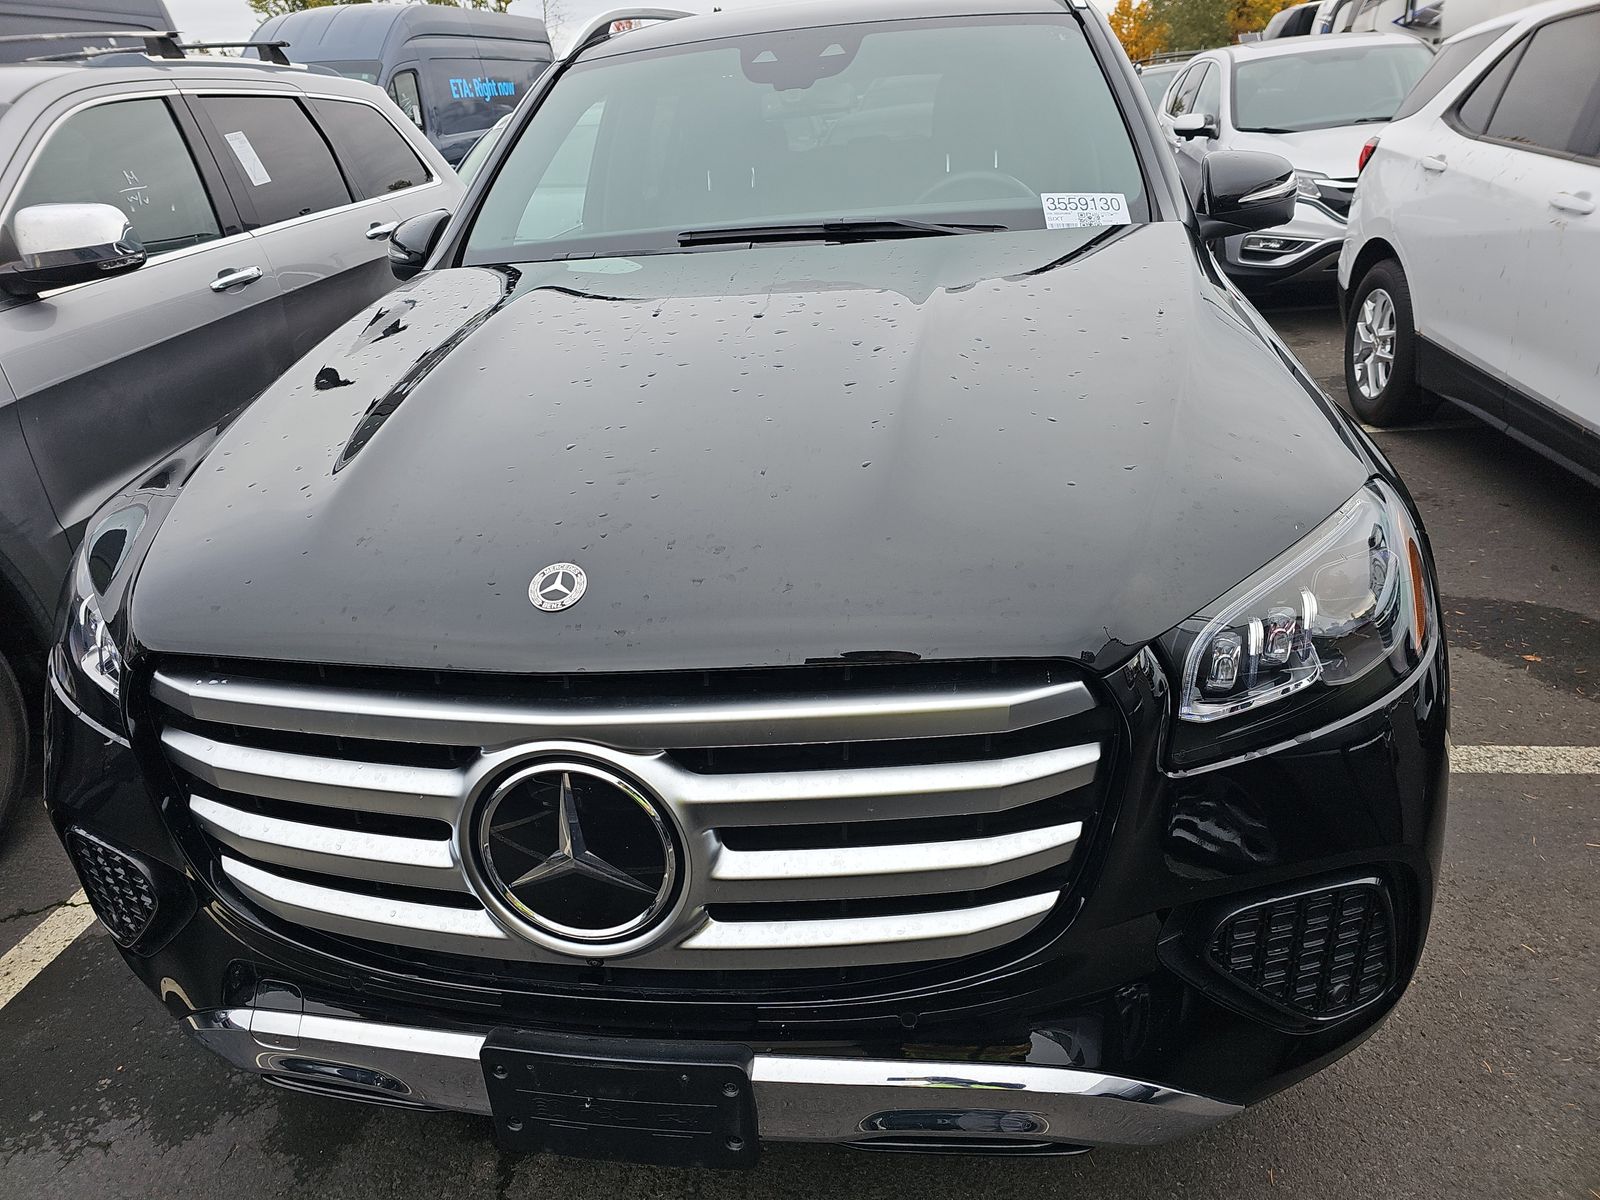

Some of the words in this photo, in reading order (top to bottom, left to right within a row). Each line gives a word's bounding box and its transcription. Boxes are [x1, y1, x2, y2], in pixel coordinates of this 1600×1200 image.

[449, 79, 474, 98] ETA:
[473, 77, 498, 101] Right
[497, 81, 515, 95] now
[1046, 197, 1121, 211] 3559130
